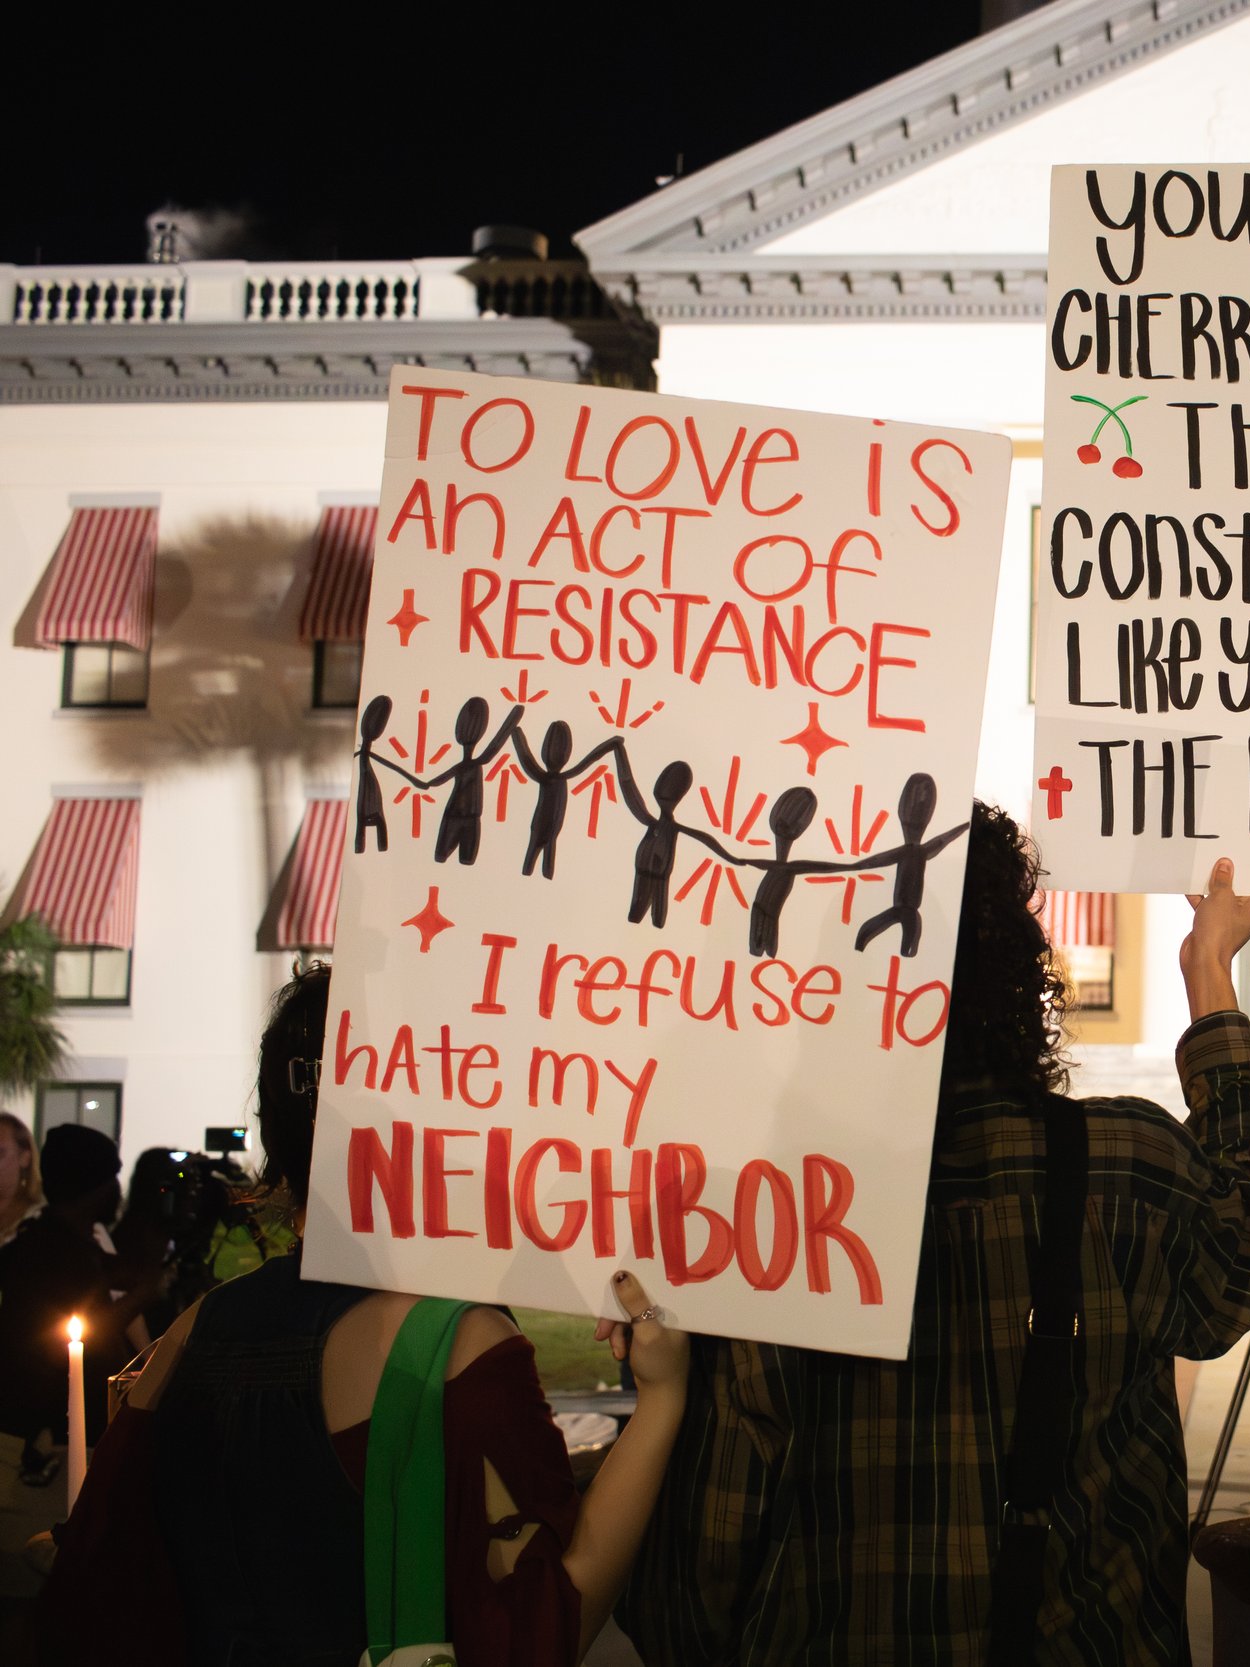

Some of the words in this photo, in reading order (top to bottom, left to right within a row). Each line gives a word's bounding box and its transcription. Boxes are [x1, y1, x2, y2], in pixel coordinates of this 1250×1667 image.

[402, 385, 535, 473] TO
[528, 497, 712, 589] ACT
[460, 568, 931, 732] RESISTANCE
[1079, 736, 1222, 838] THE
[472, 933, 517, 1014] I
[539, 944, 841, 1030] refuse
[868, 956, 951, 1050] to
[529, 1047, 657, 1148] my
[348, 1121, 883, 1305] NEIGHBOR
